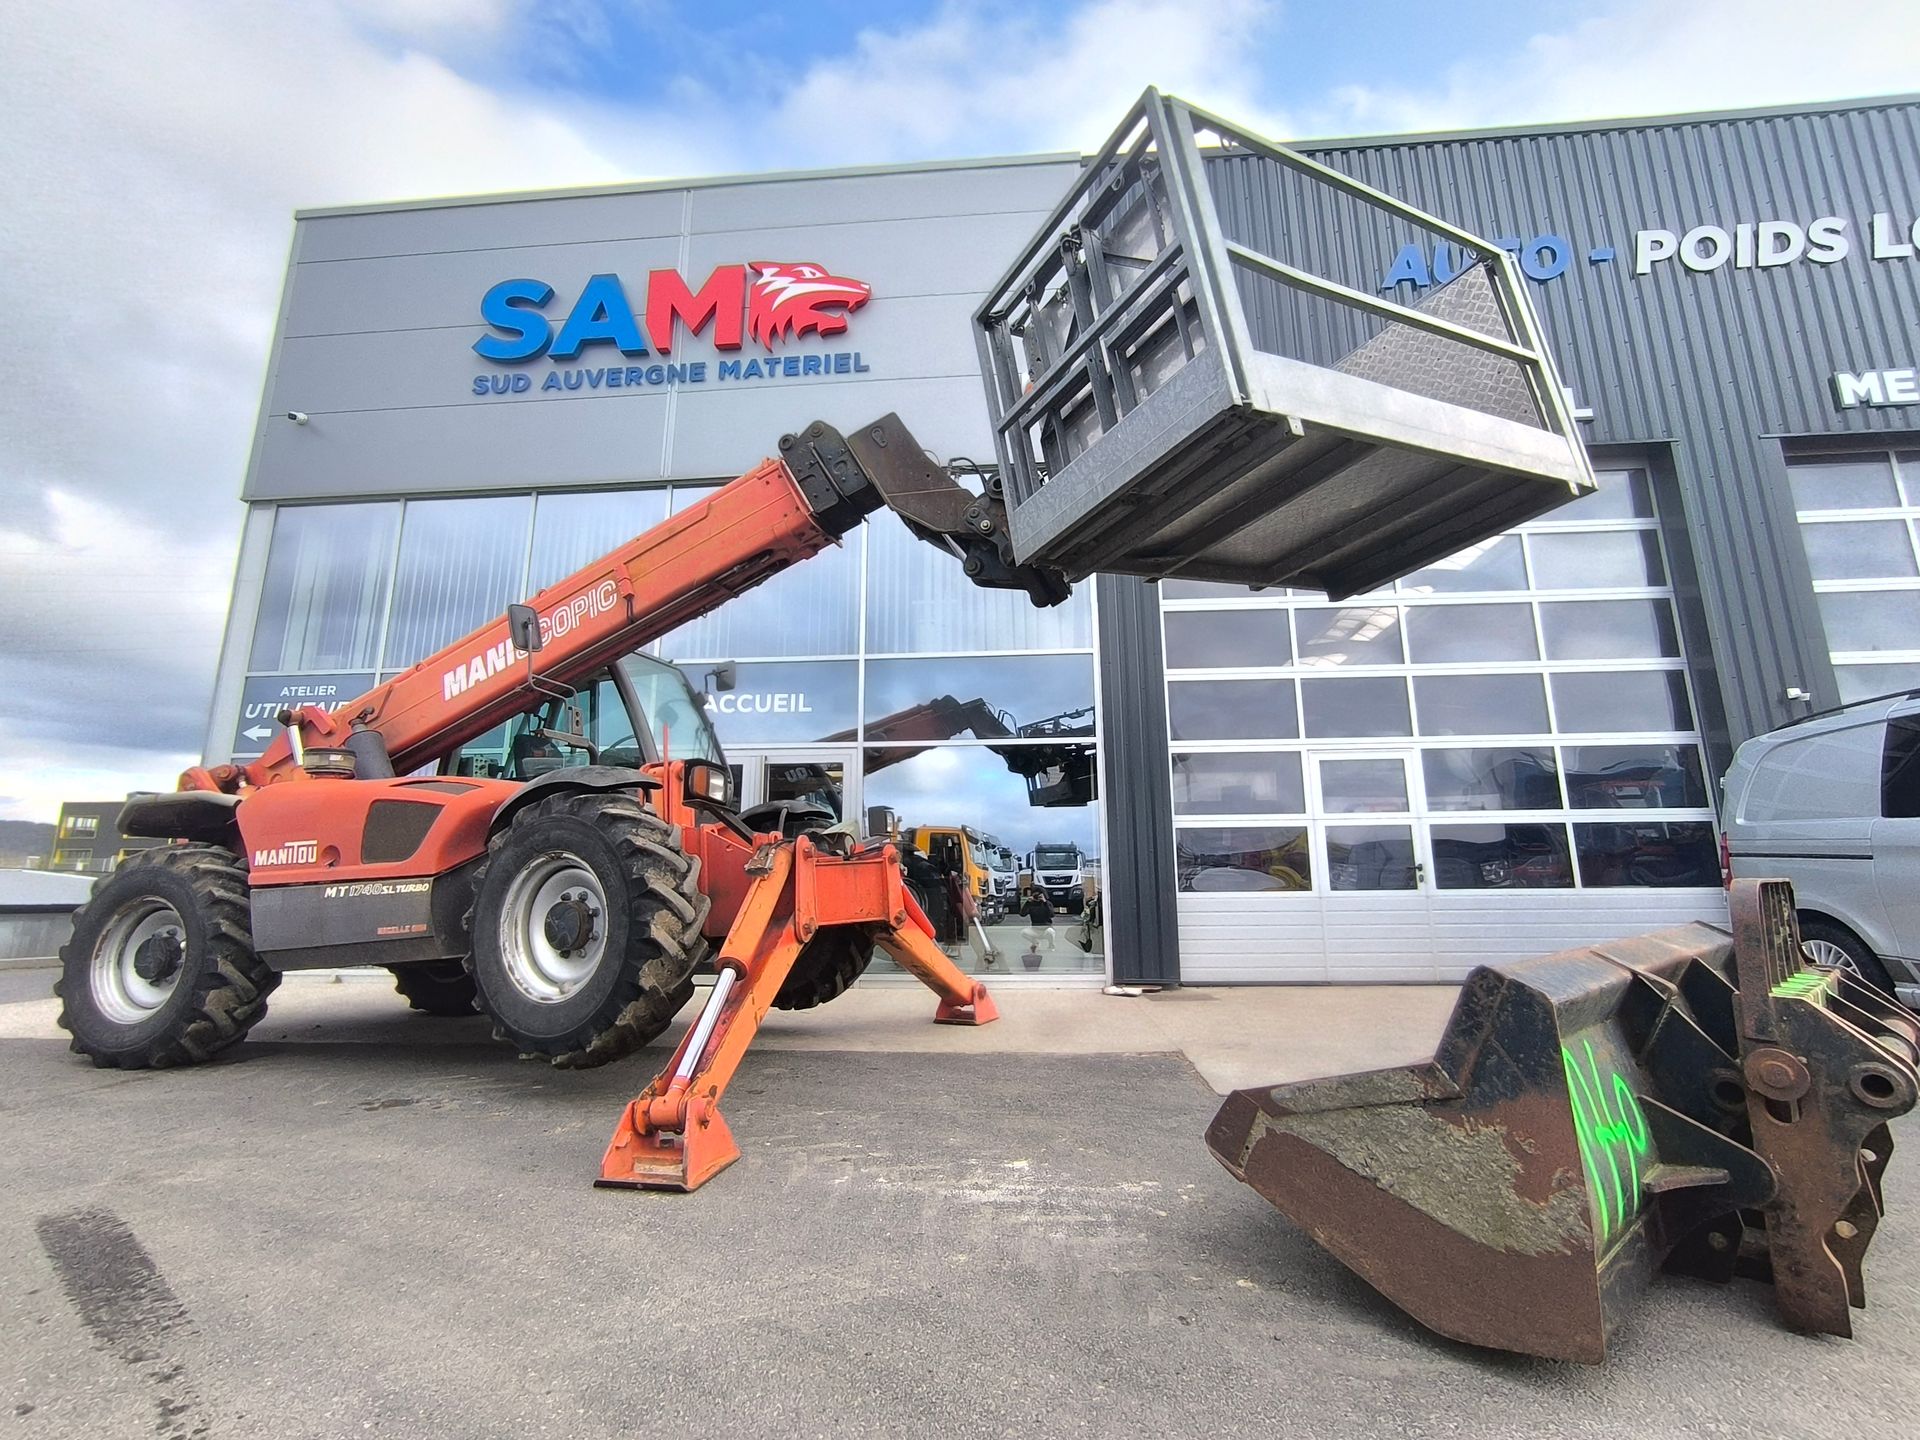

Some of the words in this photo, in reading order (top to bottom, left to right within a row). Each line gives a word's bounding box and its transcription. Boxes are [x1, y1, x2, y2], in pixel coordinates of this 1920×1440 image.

[1635, 216, 1849, 275] POIDS
[1873, 212, 1920, 261] L
[472, 264, 746, 364] SAM
[472, 374, 530, 396] SUD
[542, 361, 707, 392] AUVERGNE
[719, 351, 870, 381] MATERIEL
[443, 580, 618, 700] MANICOPIC
[280, 685, 336, 697] ATELIER
[704, 693, 812, 713] ACCUEIL
[254, 839, 318, 867] MANITOU
[324, 885, 348, 898] MT
[396, 883, 430, 894] TURBO
